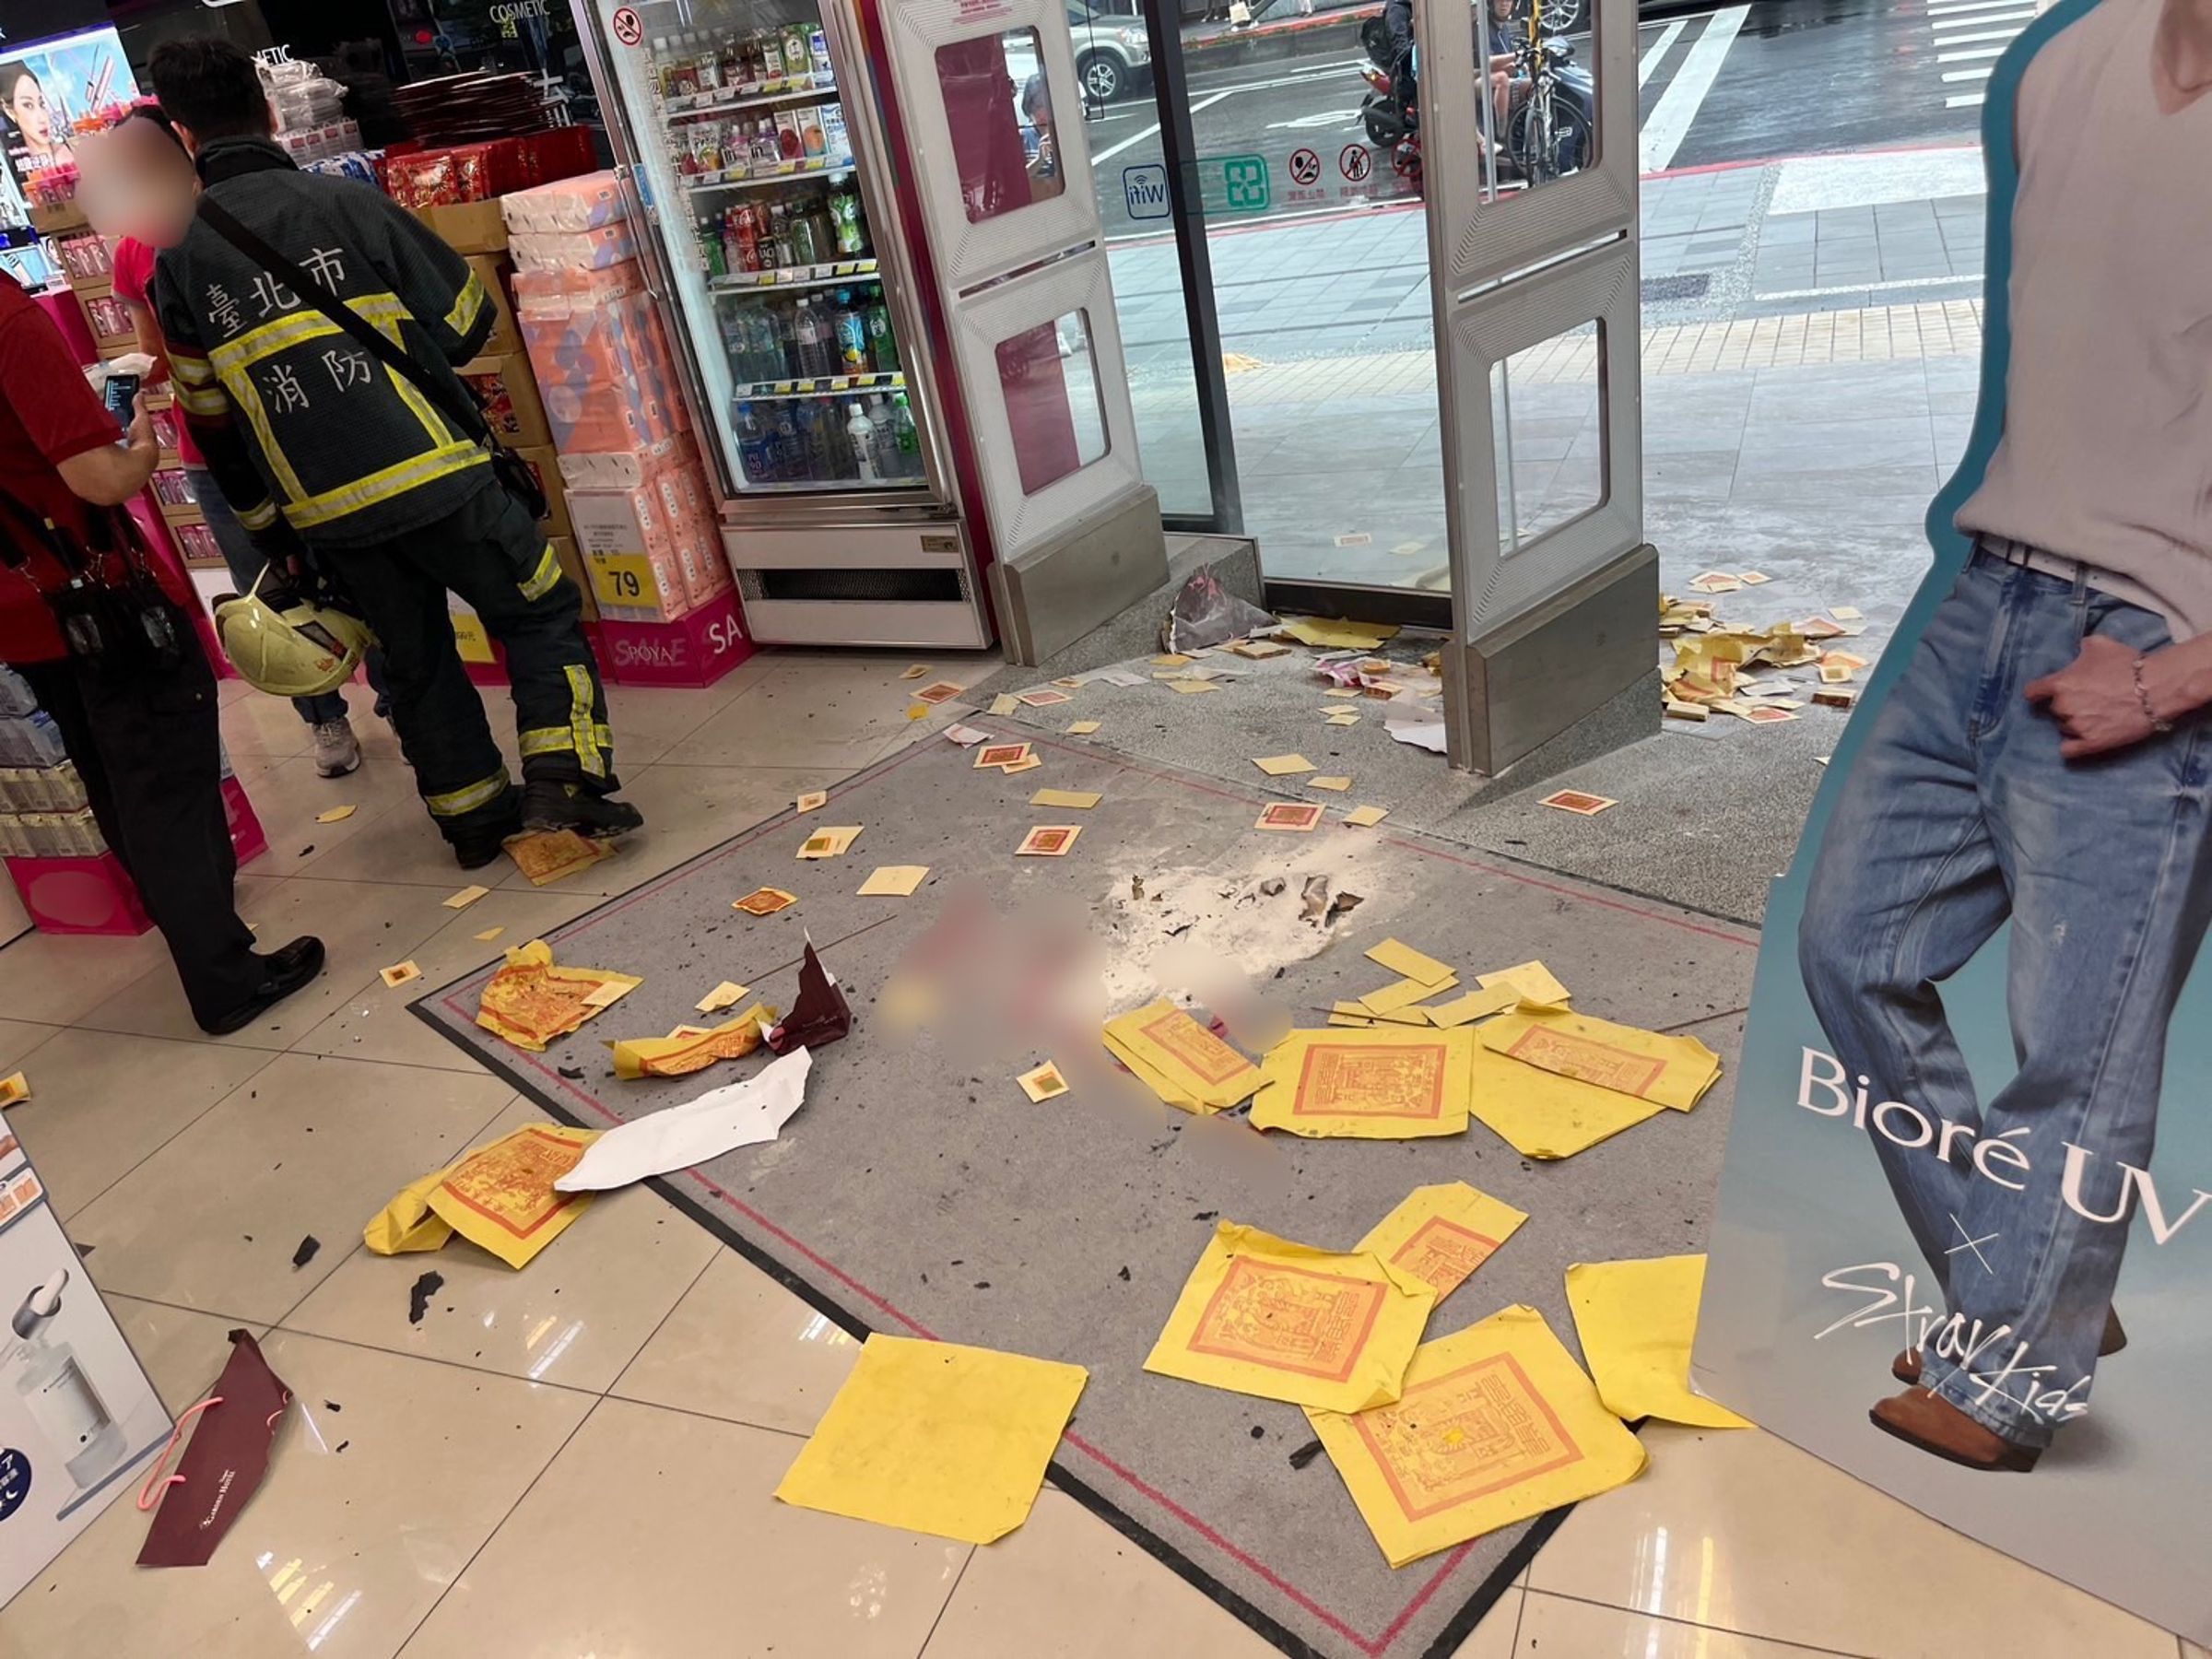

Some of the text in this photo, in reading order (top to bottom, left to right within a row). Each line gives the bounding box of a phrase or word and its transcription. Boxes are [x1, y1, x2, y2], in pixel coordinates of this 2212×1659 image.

[489, 0, 551, 24] COSMETIC
[207, 245, 347, 338] 臺北市
[262, 348, 372, 415] 消防
[607, 570, 641, 597] 79
[709, 613, 744, 655] SA
[1796, 1045, 2031, 1193] Bioré
[2061, 1141, 2212, 1246] UV
[1814, 1261, 2092, 1425] Stray Kids
